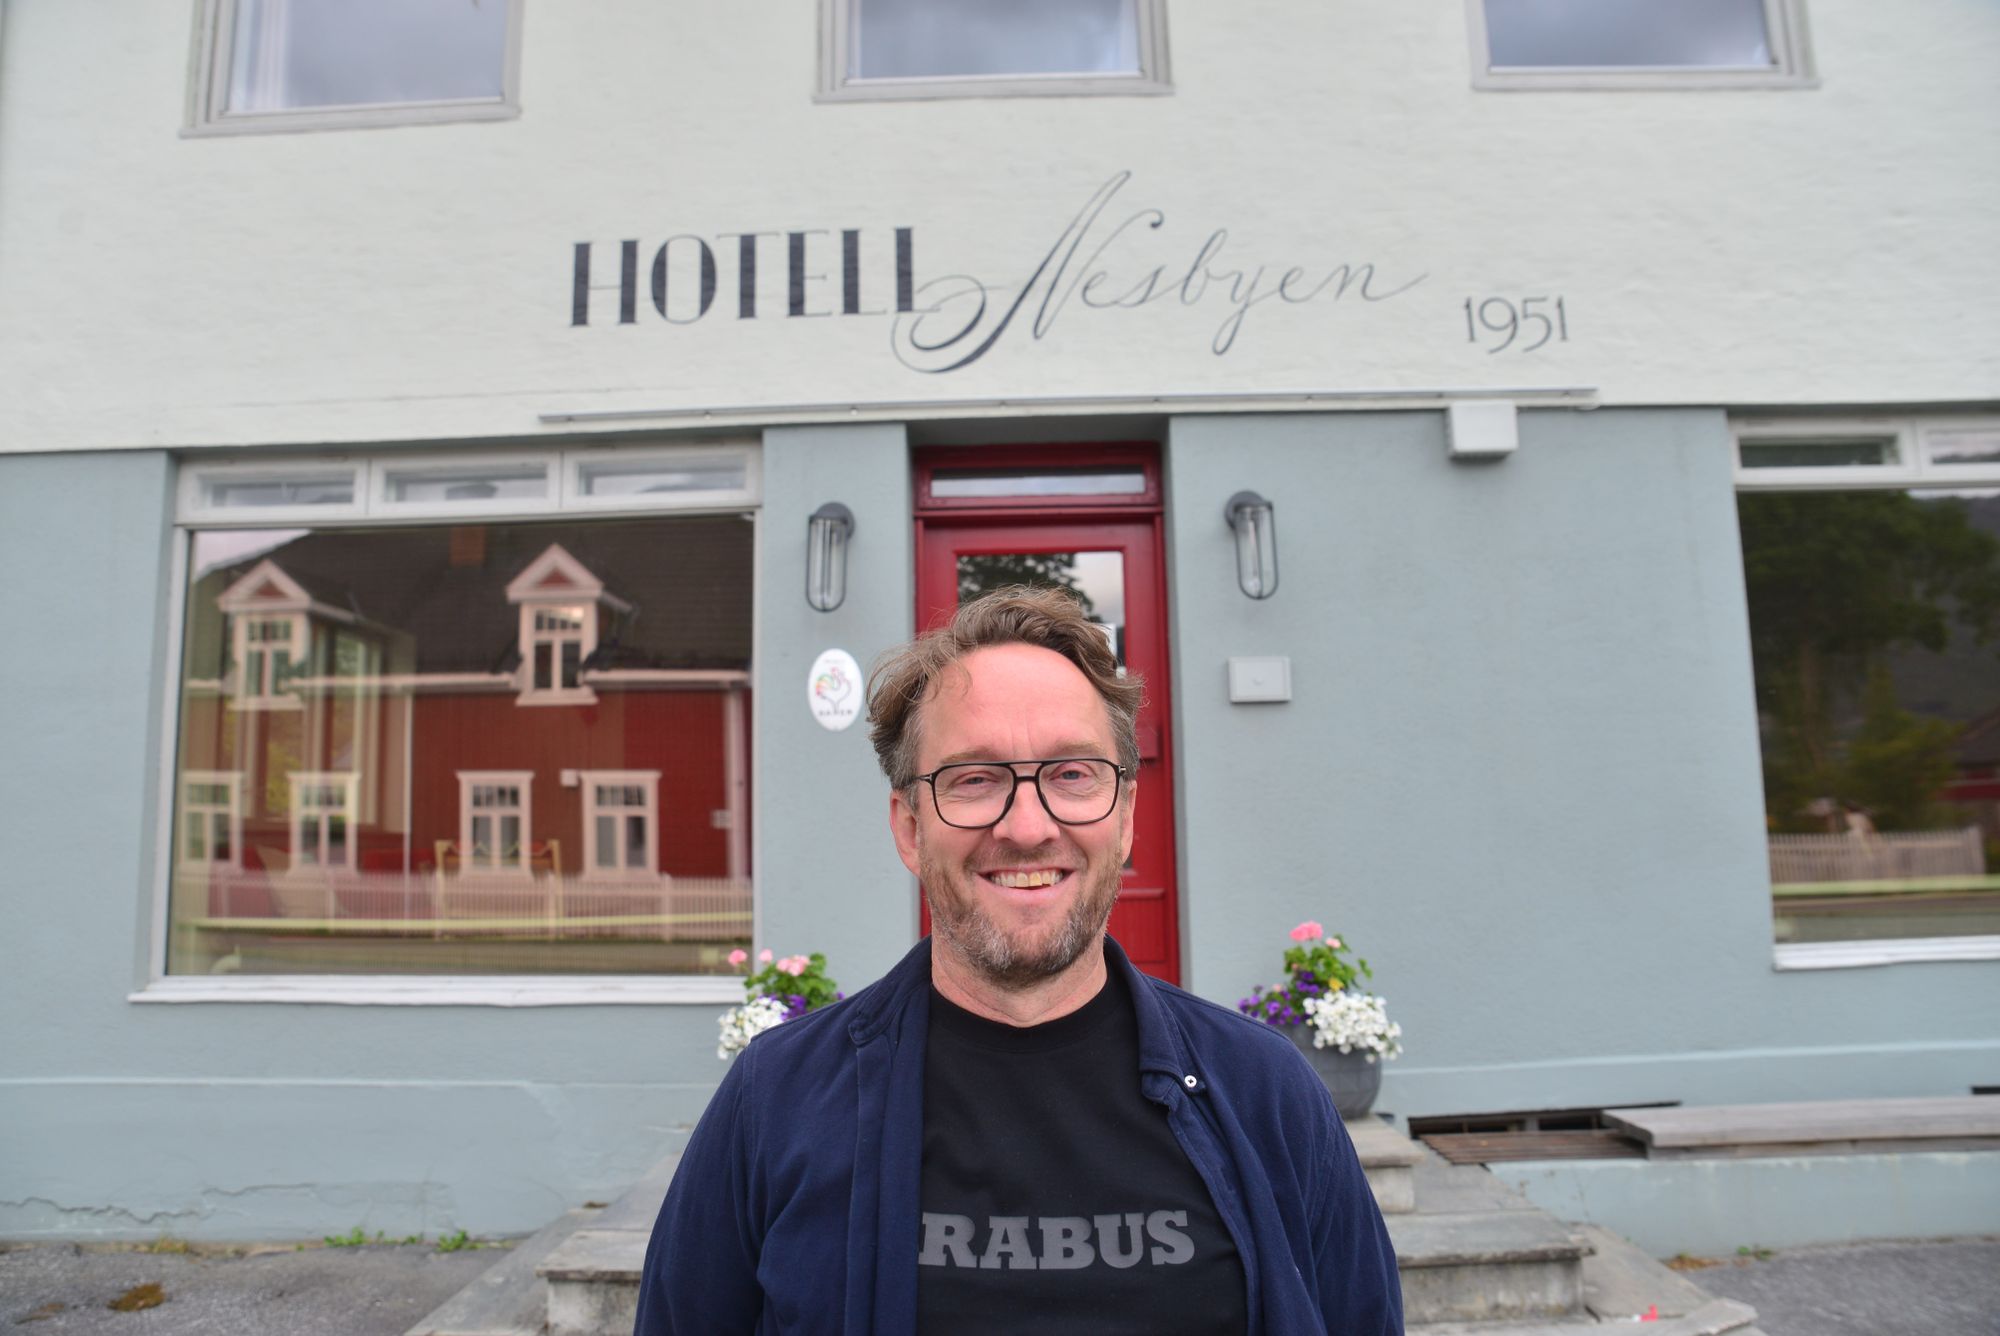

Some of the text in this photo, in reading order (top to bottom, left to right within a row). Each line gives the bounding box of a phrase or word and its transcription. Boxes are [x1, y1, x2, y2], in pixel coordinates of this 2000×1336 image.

[569, 170, 1430, 375] HOTELL Nesbyen
[1463, 295, 1569, 354] 1951
[918, 1209, 1195, 1270] RABUS
